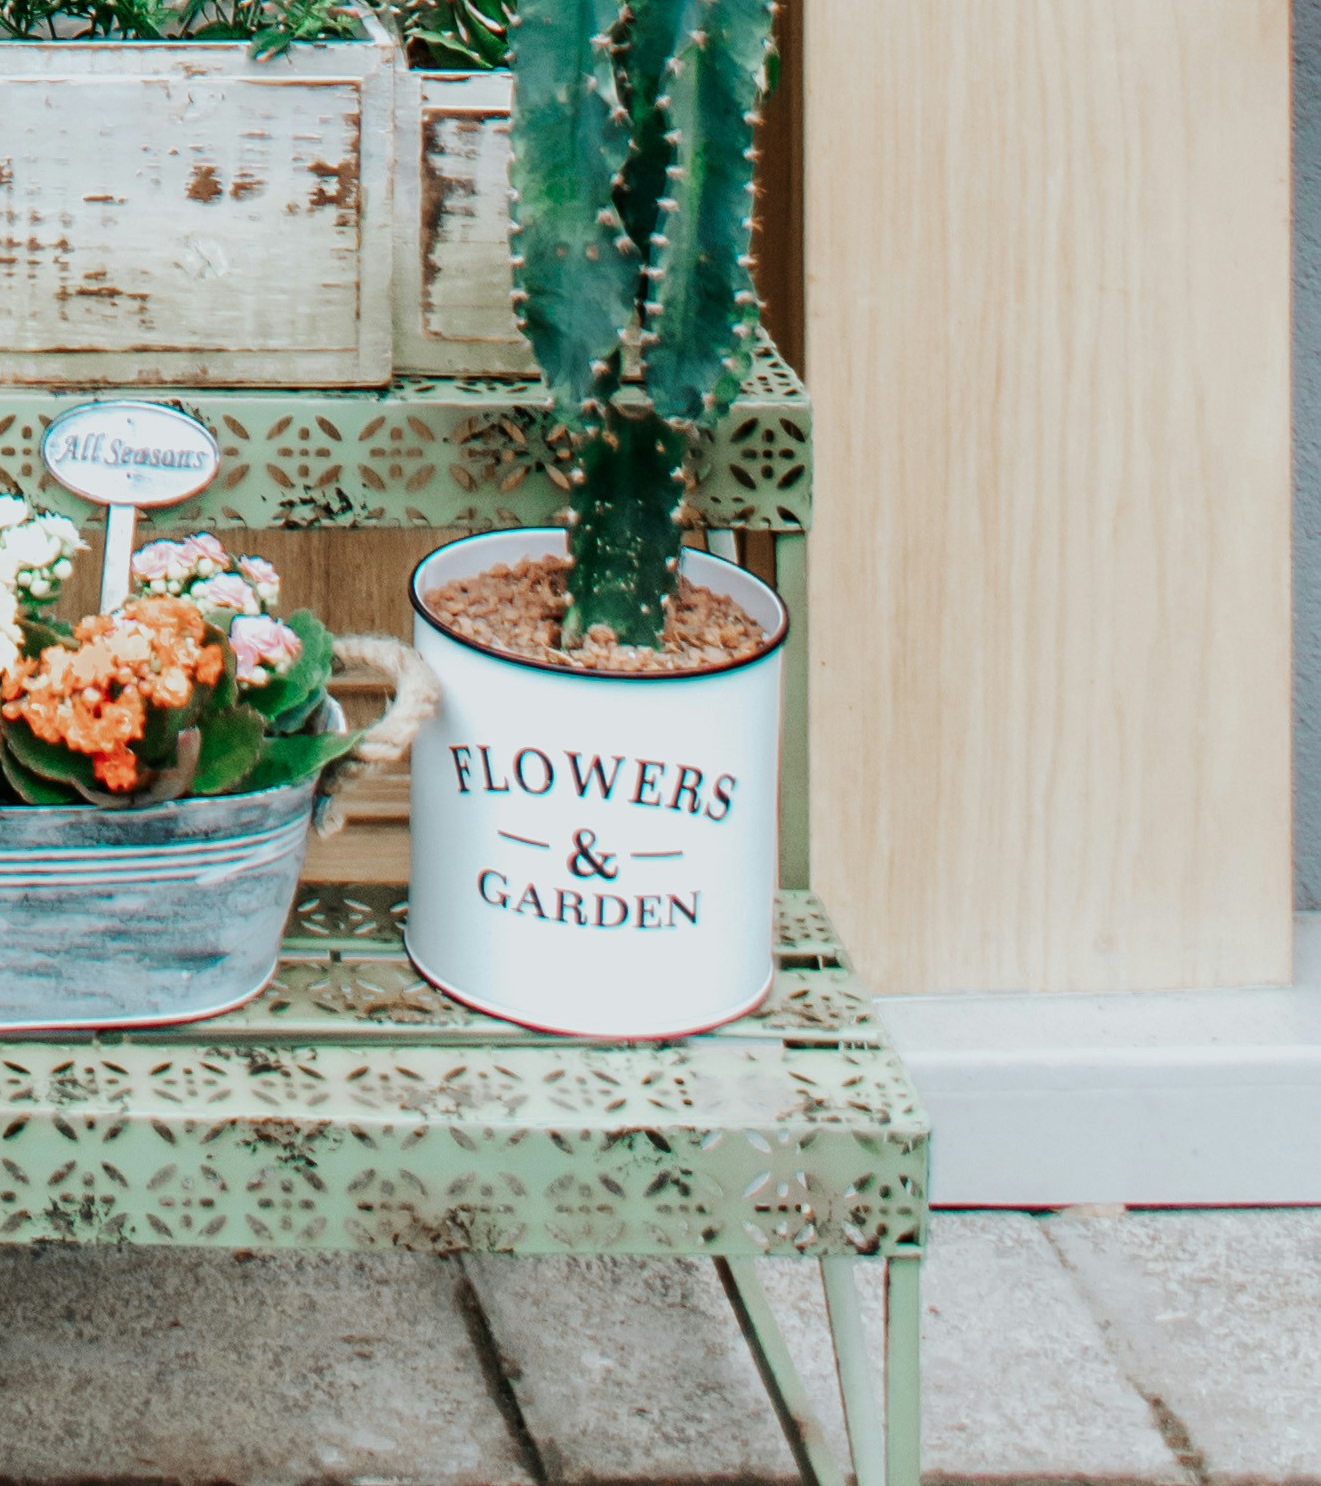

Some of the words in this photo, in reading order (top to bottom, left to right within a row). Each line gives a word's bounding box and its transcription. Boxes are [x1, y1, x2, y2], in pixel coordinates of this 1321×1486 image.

[54, 432, 105, 466] All
[103, 437, 210, 470] Seasons
[448, 740, 740, 822] FLOWERS
[567, 827, 619, 881] &
[477, 865, 700, 933] GARDEN
